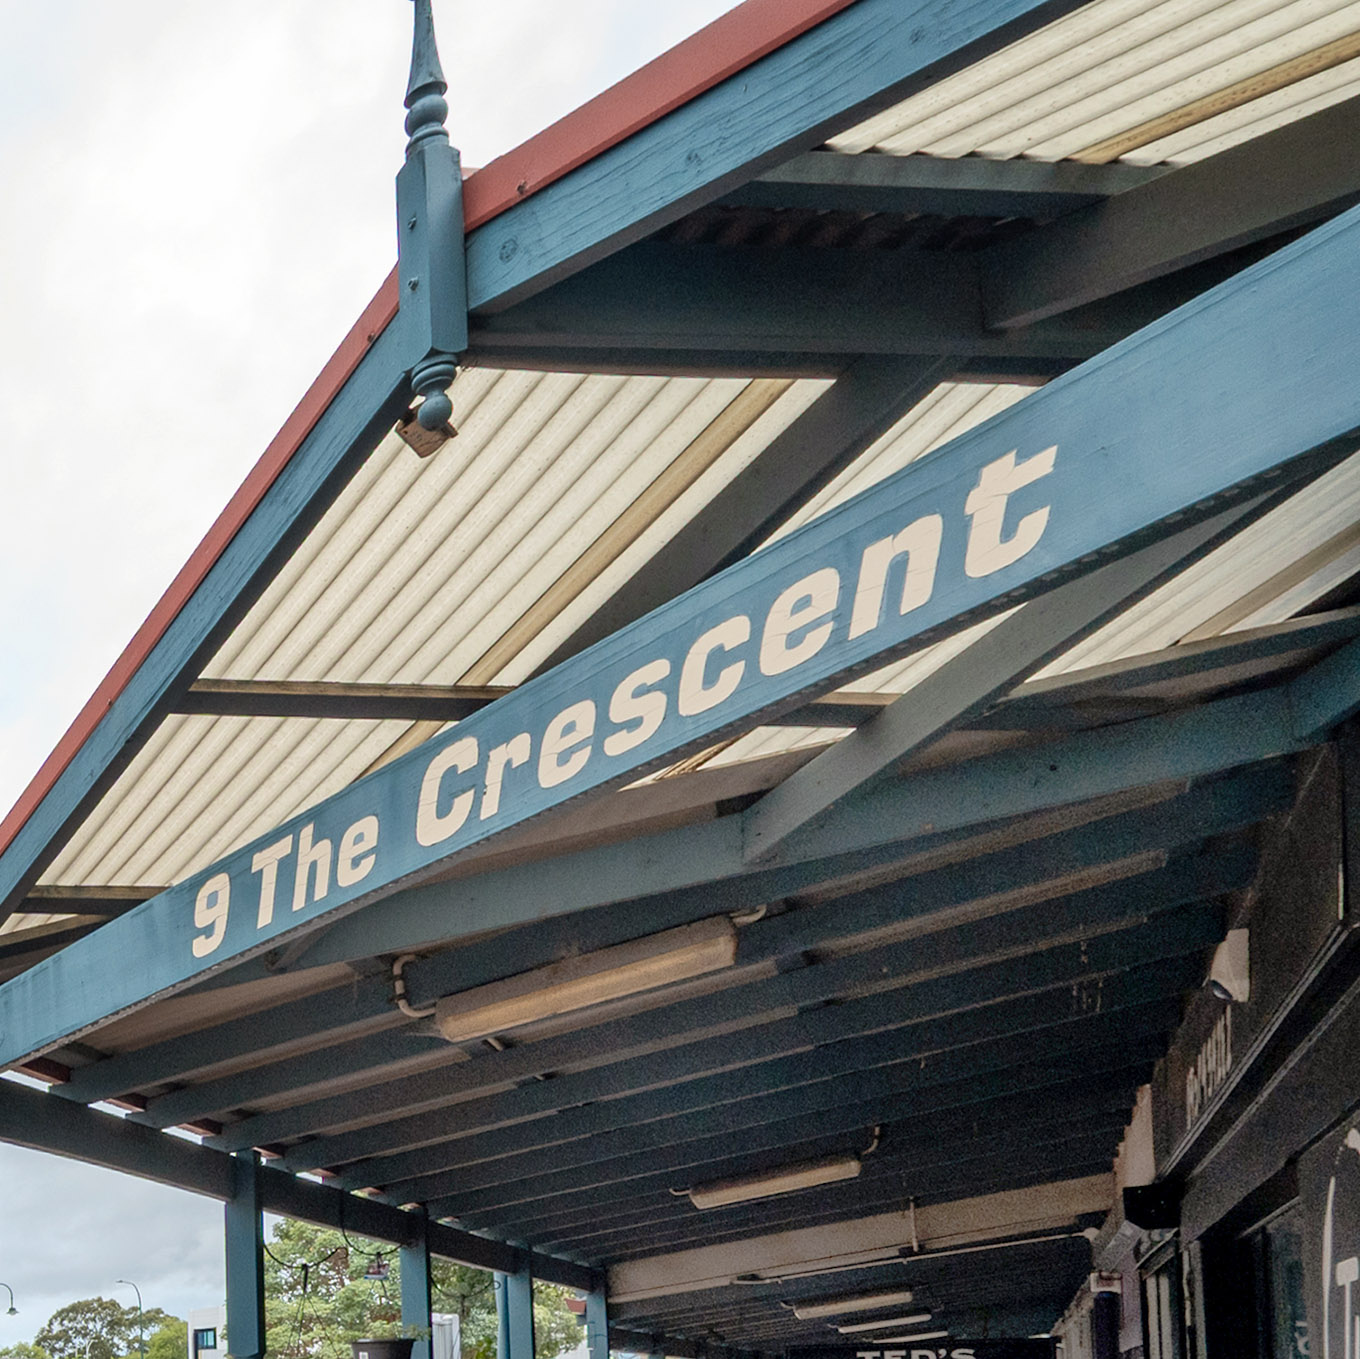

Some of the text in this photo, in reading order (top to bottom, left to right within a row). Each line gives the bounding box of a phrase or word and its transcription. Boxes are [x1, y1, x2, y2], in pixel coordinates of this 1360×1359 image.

[192, 444, 1059, 958] 9 The Crescent
